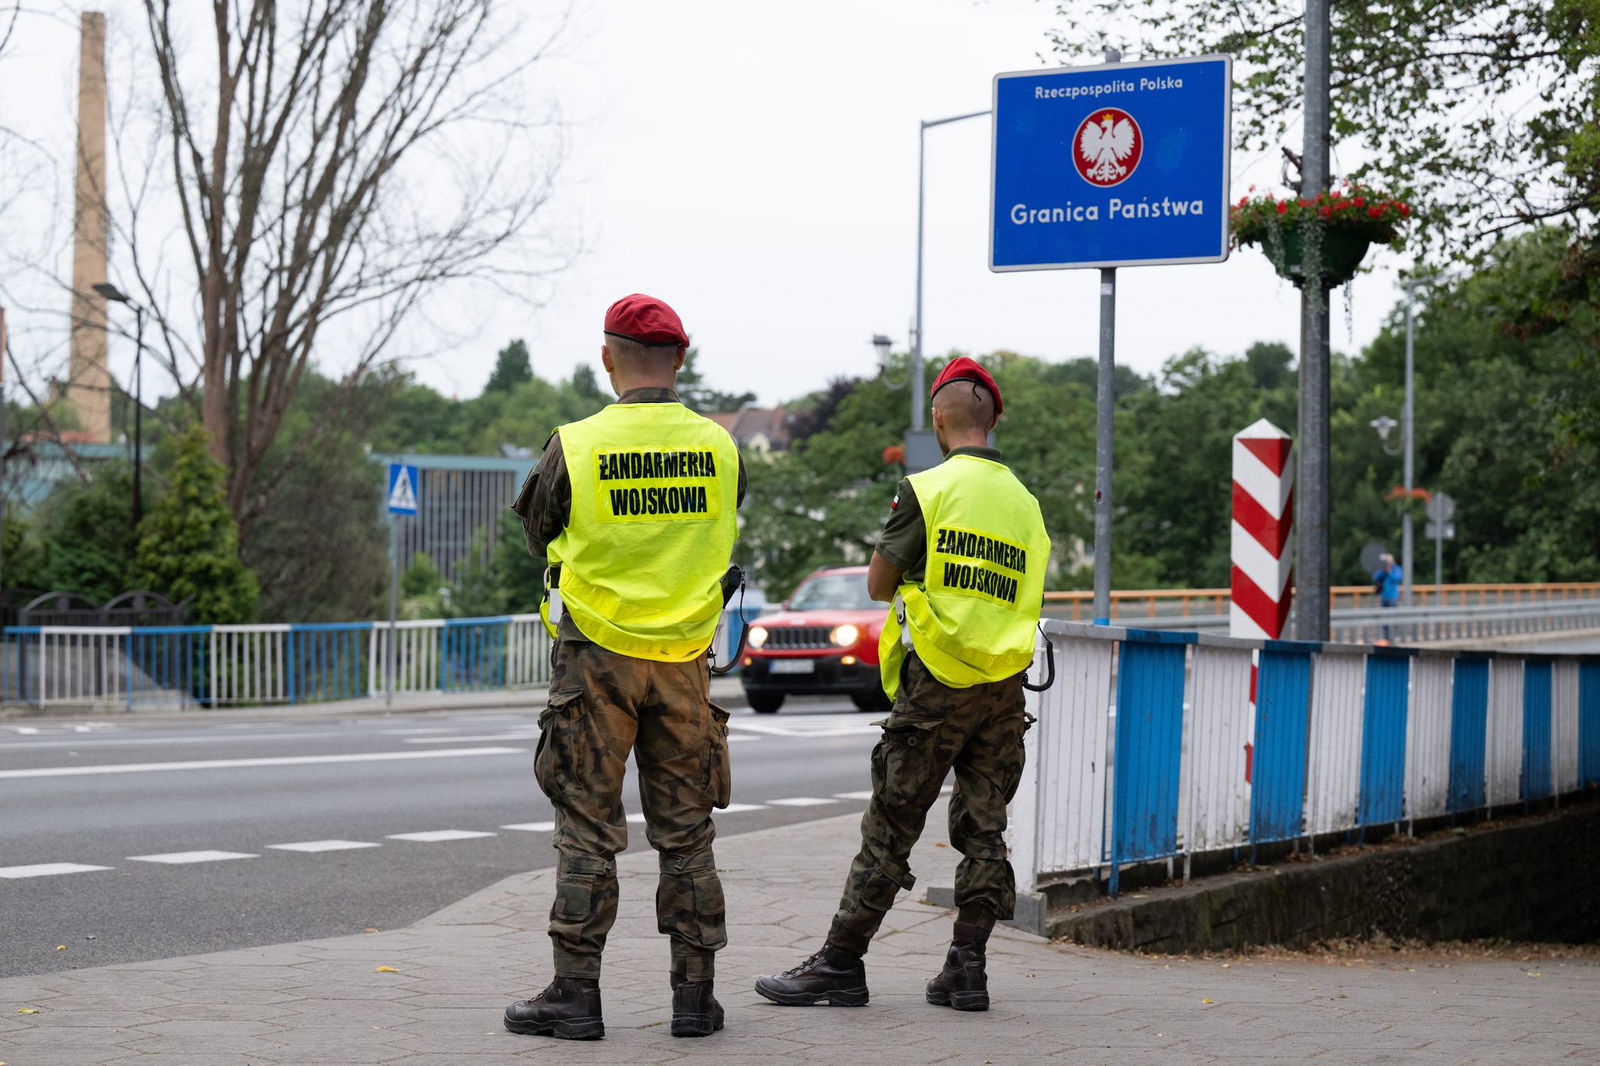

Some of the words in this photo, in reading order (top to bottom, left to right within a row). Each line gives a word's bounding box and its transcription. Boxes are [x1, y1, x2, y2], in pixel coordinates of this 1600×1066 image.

[1035, 81, 1135, 99] Rzeczpospolita
[1140, 76, 1183, 91] Polska
[1010, 201, 1099, 225] Granica
[1109, 196, 1204, 219] Państwa
[610, 486, 708, 516] WOJSKOWA
[943, 562, 1018, 604] WOJSKOWA
